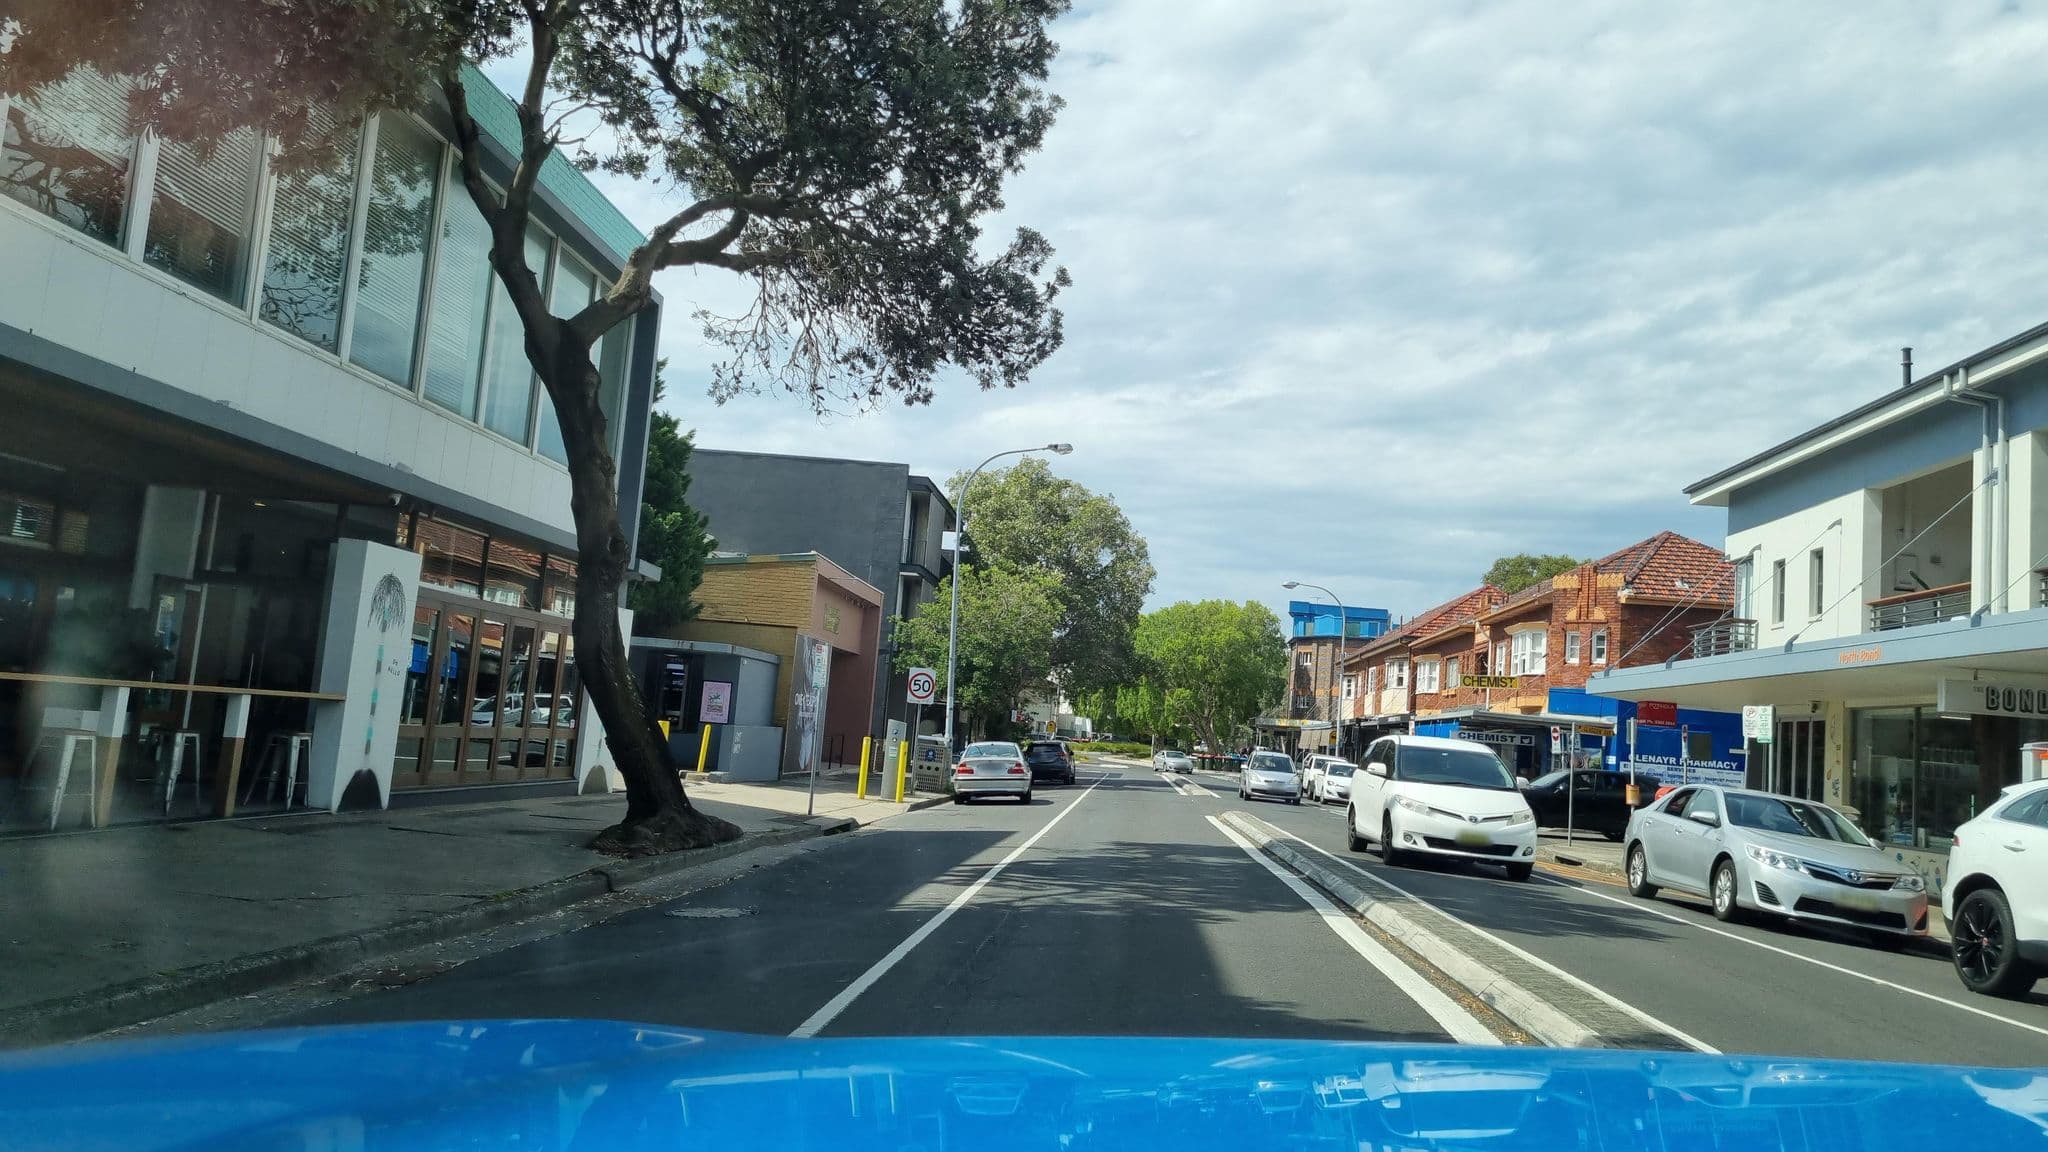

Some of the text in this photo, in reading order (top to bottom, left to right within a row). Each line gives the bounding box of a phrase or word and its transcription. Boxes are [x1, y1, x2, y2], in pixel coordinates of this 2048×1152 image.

[912, 679, 931, 693] 50
[1462, 675, 1516, 688] CHEMIST
[1458, 731, 1517, 743] CHEMIST
[1679, 758, 1739, 770] PHARMACY
